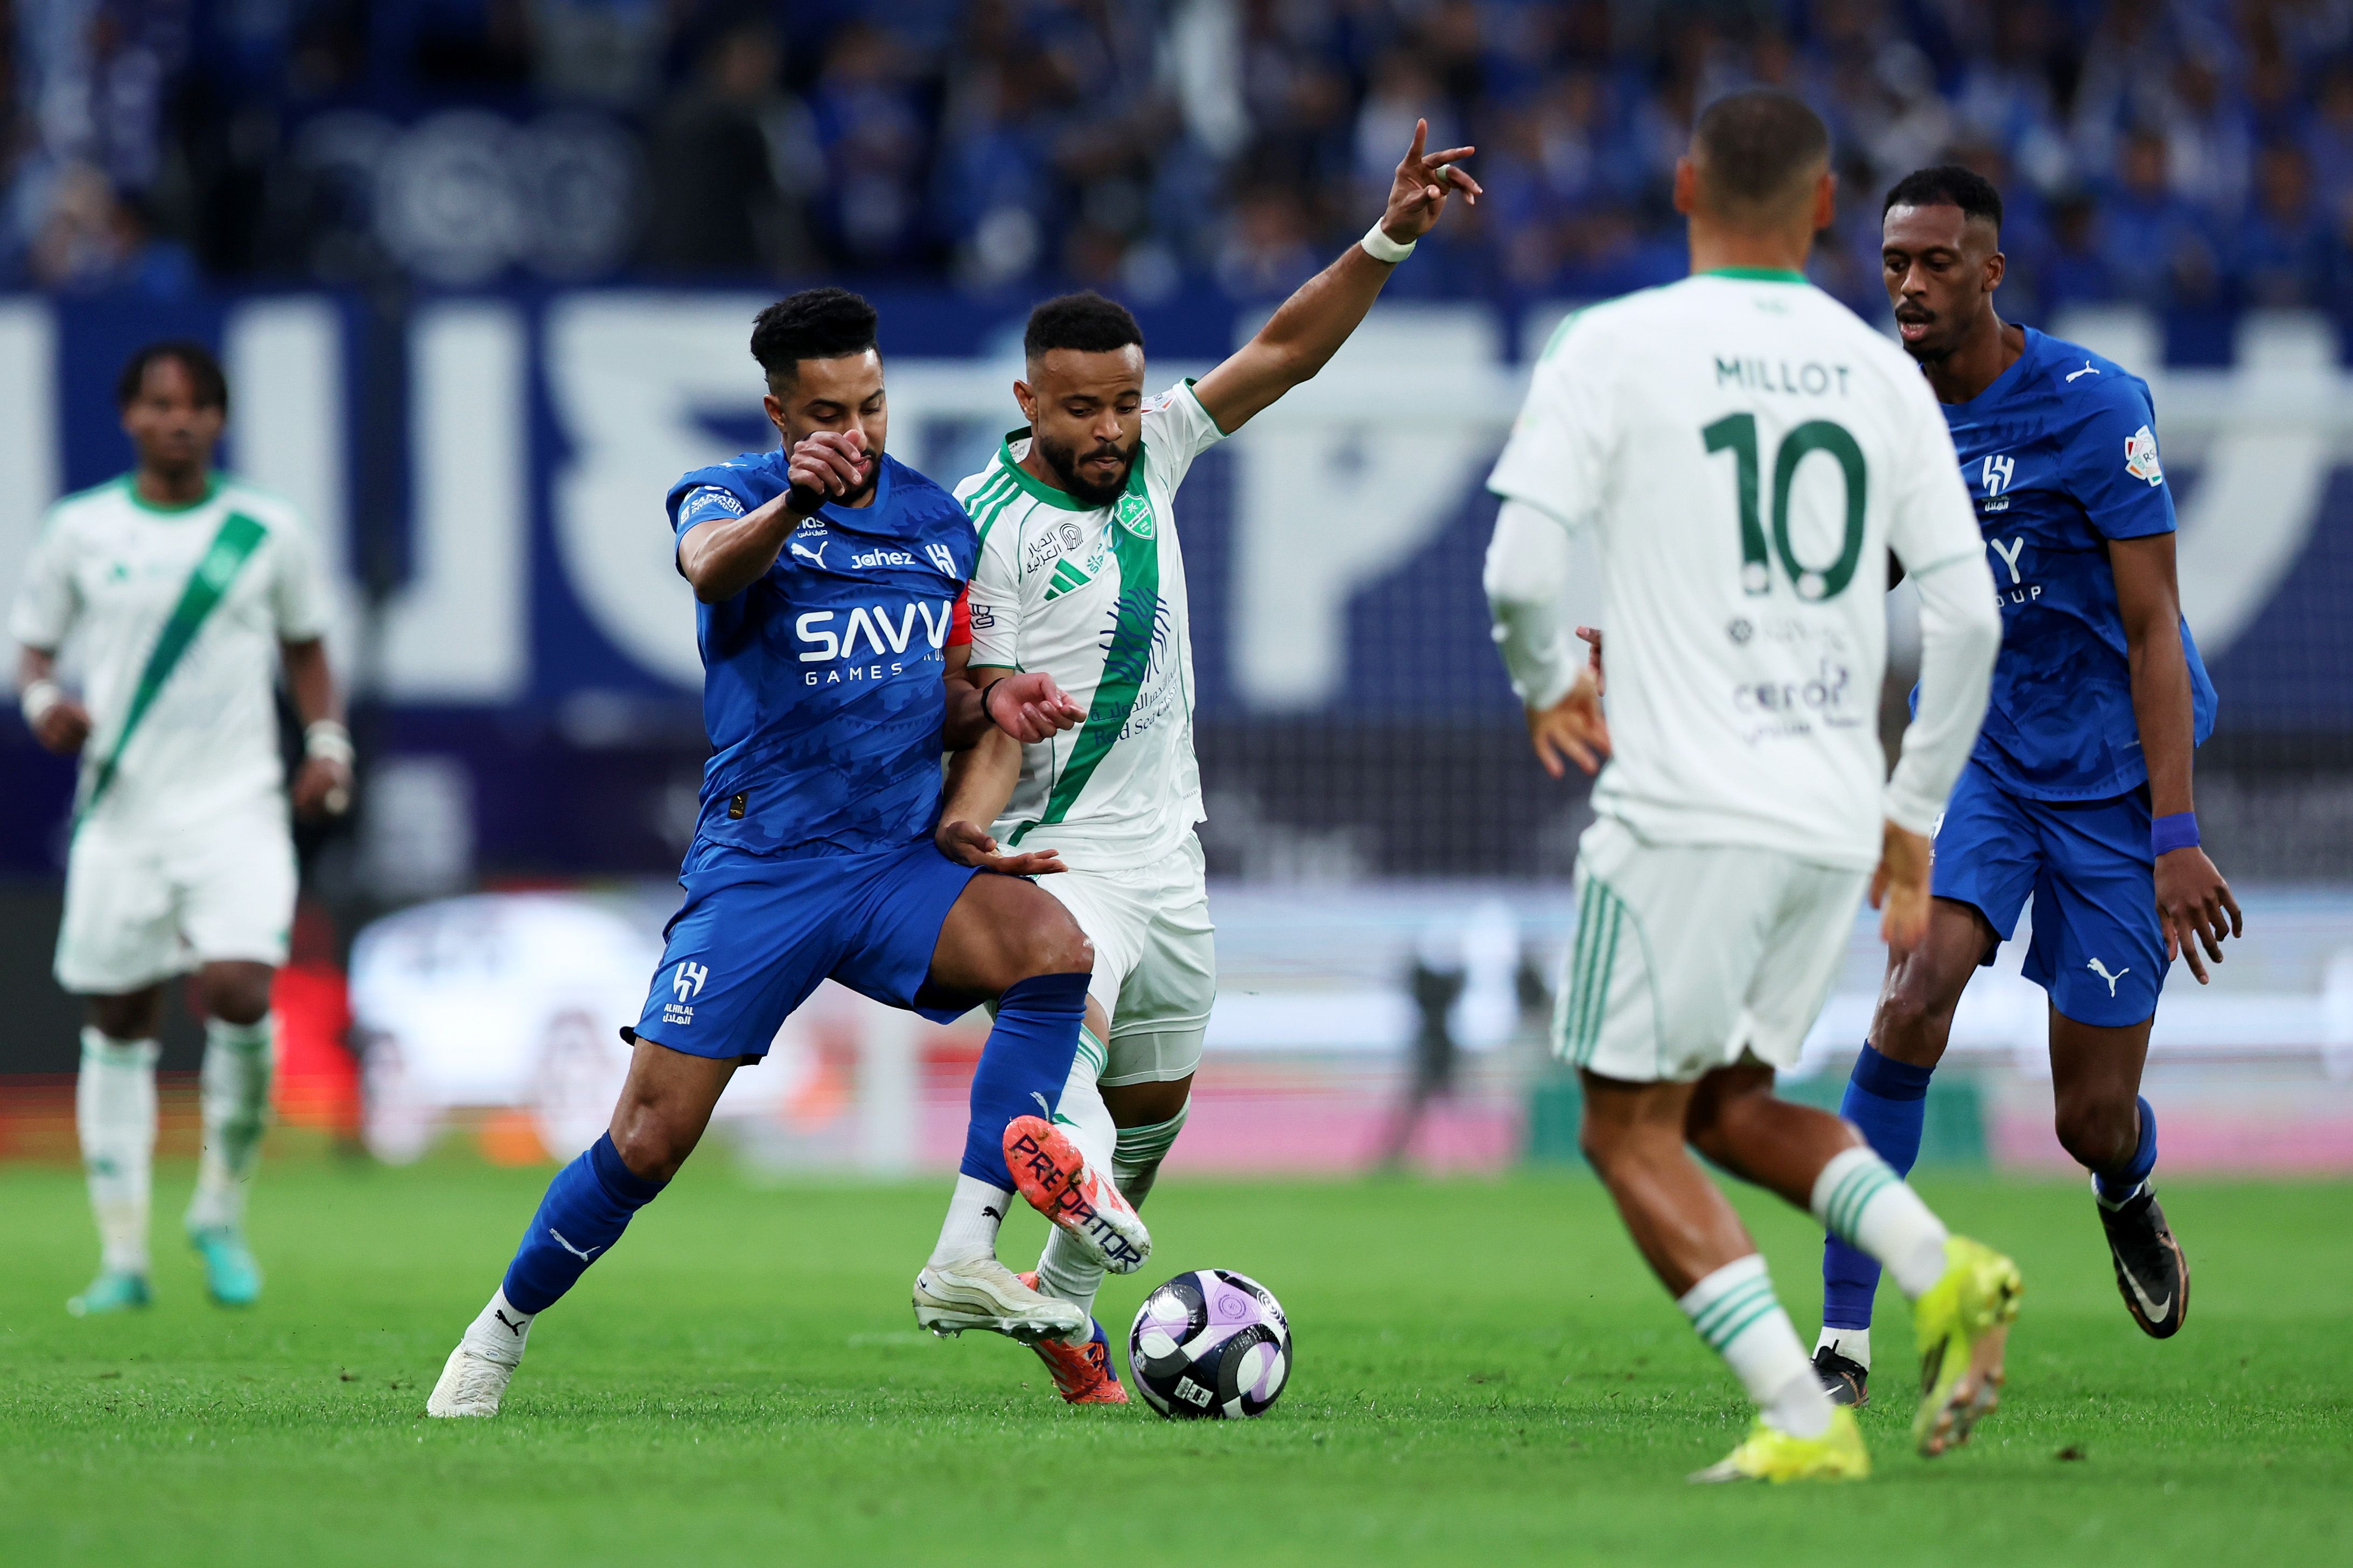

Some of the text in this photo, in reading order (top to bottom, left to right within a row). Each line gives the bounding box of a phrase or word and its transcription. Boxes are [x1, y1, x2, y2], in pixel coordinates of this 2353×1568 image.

[1714, 357, 1850, 398] MILLOT
[1701, 412, 1866, 602] 10
[806, 663, 902, 685] GAMES
[1094, 722, 1130, 748] Red
[1135, 713, 1155, 734] Sea
[662, 1013, 691, 1025] الهلال
[664, 1003, 694, 1016] ALHILAL
[1009, 1134, 1141, 1271] PREDATOR
